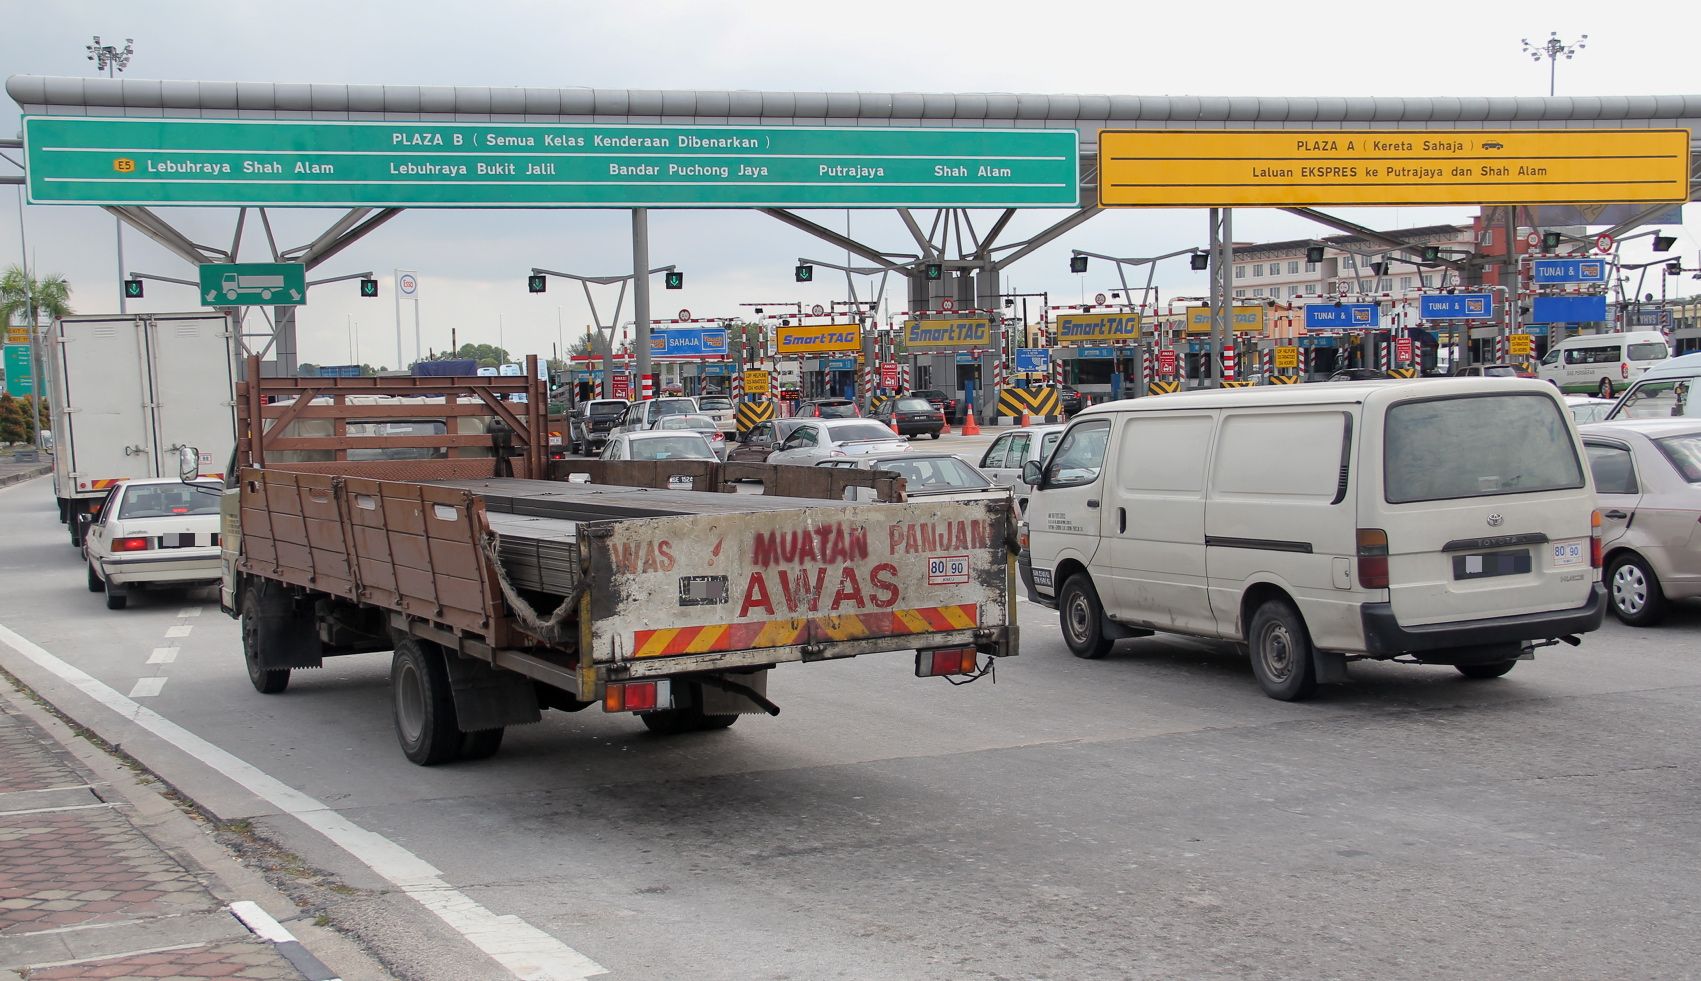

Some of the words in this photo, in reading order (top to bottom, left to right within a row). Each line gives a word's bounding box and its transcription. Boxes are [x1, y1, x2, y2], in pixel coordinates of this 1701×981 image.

[393, 132, 444, 146] PLAZA
[453, 133, 464, 146] B
[486, 133, 535, 146] Semua
[545, 134, 585, 147] Kelas
[594, 134, 670, 148] Kenderaan
[678, 135, 759, 148] Dibenarkan
[1297, 140, 1338, 152] PLAZA
[1346, 140, 1355, 152] A
[1373, 140, 1413, 152] Kereta
[1423, 140, 1464, 154] Sahaja
[118, 160, 131, 170] E5
[147, 160, 231, 176] Lebuhraya
[243, 161, 283, 174] Shah
[294, 162, 334, 174] Alam
[390, 162, 468, 177] Lebuhraya
[477, 163, 516, 175] Bukit
[525, 163, 556, 175] Jalil
[609, 163, 660, 176] Bandar
[668, 163, 729, 178] Puchong
[737, 164, 769, 178] Jaya
[819, 164, 885, 179] Putrajaya
[934, 165, 968, 177] Shah
[977, 165, 1011, 177] Alam
[1252, 166, 1294, 178] Laluan
[1301, 166, 1358, 178] EKSPRES
[1365, 166, 1379, 177] ke
[1386, 166, 1443, 179] Putrajaya
[1451, 166, 1473, 177] dan
[1480, 165, 1510, 177] Shah
[1517, 165, 1547, 176] Alam
[1538, 266, 1564, 277] TUNAI
[1568, 266, 1575, 276] &
[403, 279, 414, 289] Esso
[1428, 302, 1449, 311] TUNAI
[1454, 302, 1460, 310] &
[1313, 312, 1335, 320] TUNAI
[1340, 312, 1346, 320] &
[909, 322, 986, 342] SmartTAG
[1061, 317, 1136, 336] SmartTAG
[669, 338, 699, 347] SAHAJA
[782, 332, 856, 346] SmartTAG
[752, 522, 869, 569] MUATAN
[889, 519, 993, 555] PANJAN
[1477, 536, 1517, 548] TOYOTA
[1554, 546, 1565, 557] 80
[1569, 546, 1579, 557] 90
[931, 560, 945, 574] 80
[951, 562, 963, 575] 90
[738, 562, 900, 619] AWAS
